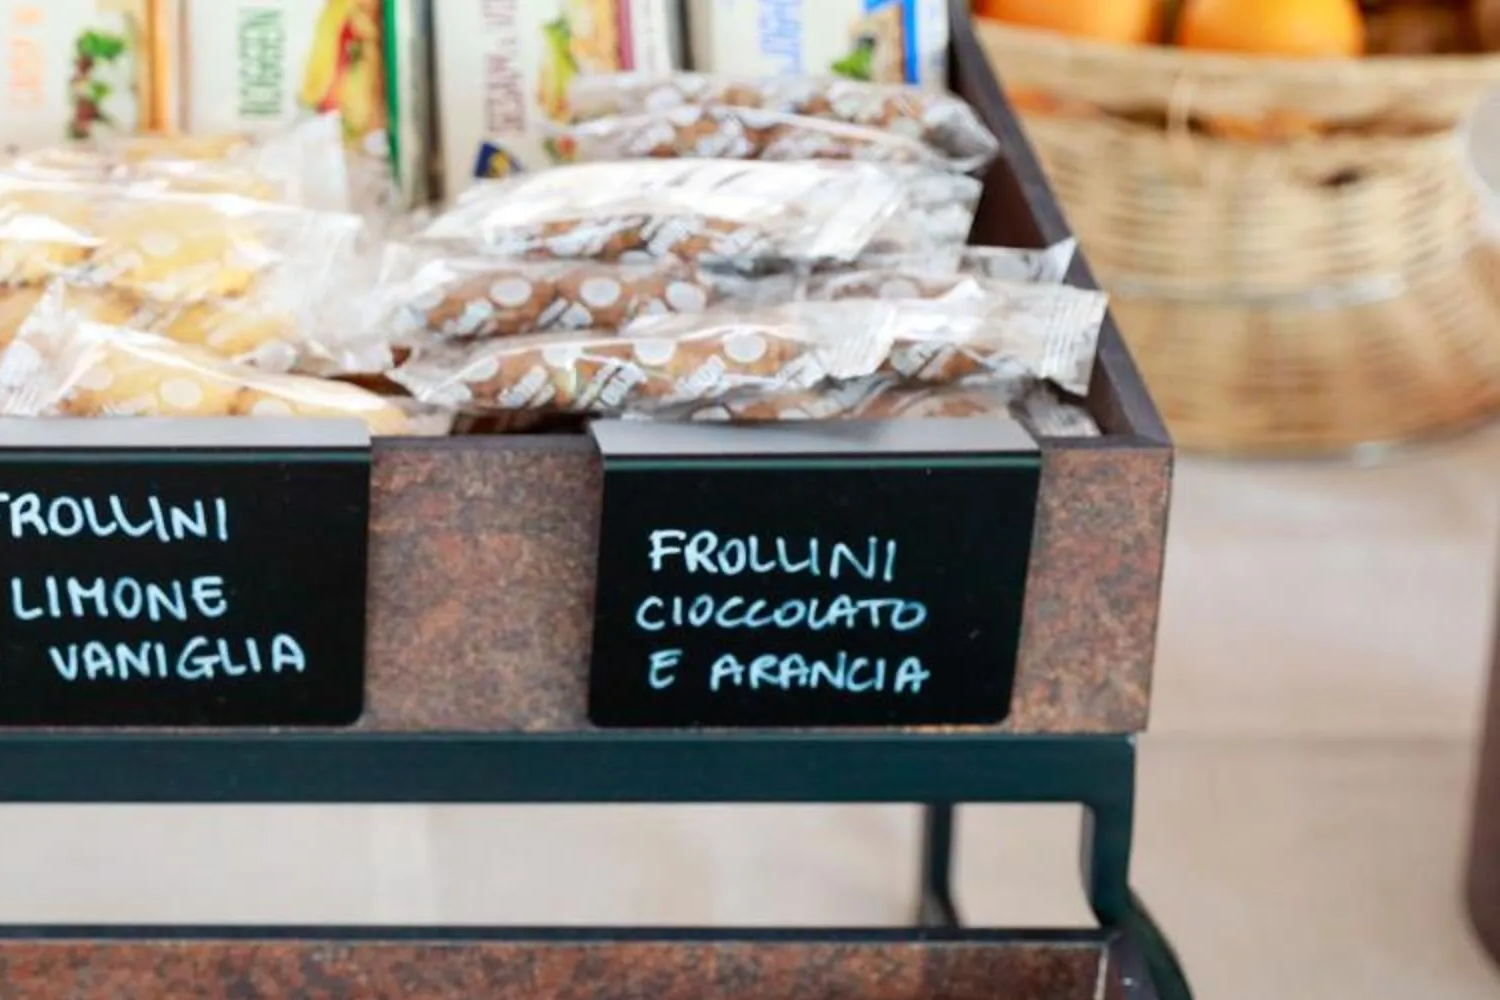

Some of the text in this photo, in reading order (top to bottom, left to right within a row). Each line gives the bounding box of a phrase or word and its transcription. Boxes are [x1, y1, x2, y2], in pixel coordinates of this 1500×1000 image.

[649, 530, 896, 581] FROLLINI
[11, 575, 227, 621] LIMONE
[636, 595, 927, 630] CIOCCOLATO
[49, 634, 306, 680] VANIGLIA
[648, 650, 930, 692] E ARANCIA
